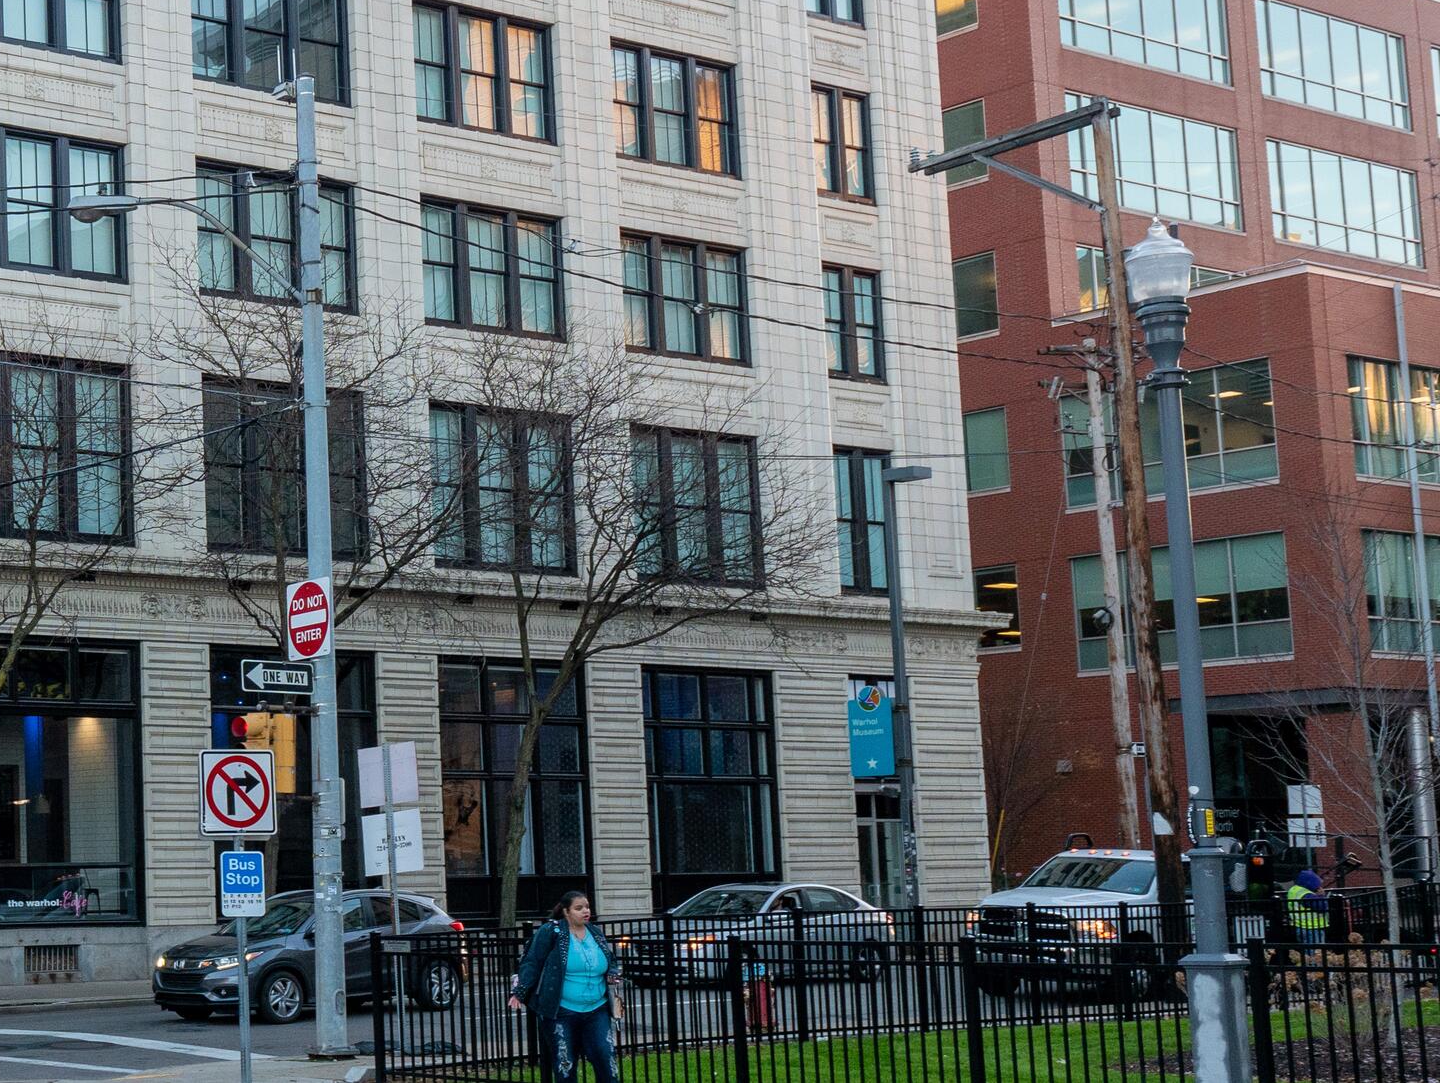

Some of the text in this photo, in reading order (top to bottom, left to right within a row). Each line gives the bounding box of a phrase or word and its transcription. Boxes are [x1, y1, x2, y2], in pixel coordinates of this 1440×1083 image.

[292, 594, 324, 611] DO NOT
[295, 627, 322, 644] ENTER
[262, 670, 305, 684] ONE WAY
[852, 718, 879, 726] Warhol
[852, 728, 884, 736] Museum
[228, 858, 256, 870] Bus
[225, 872, 260, 887] Stop
[7, 899, 24, 908] the
